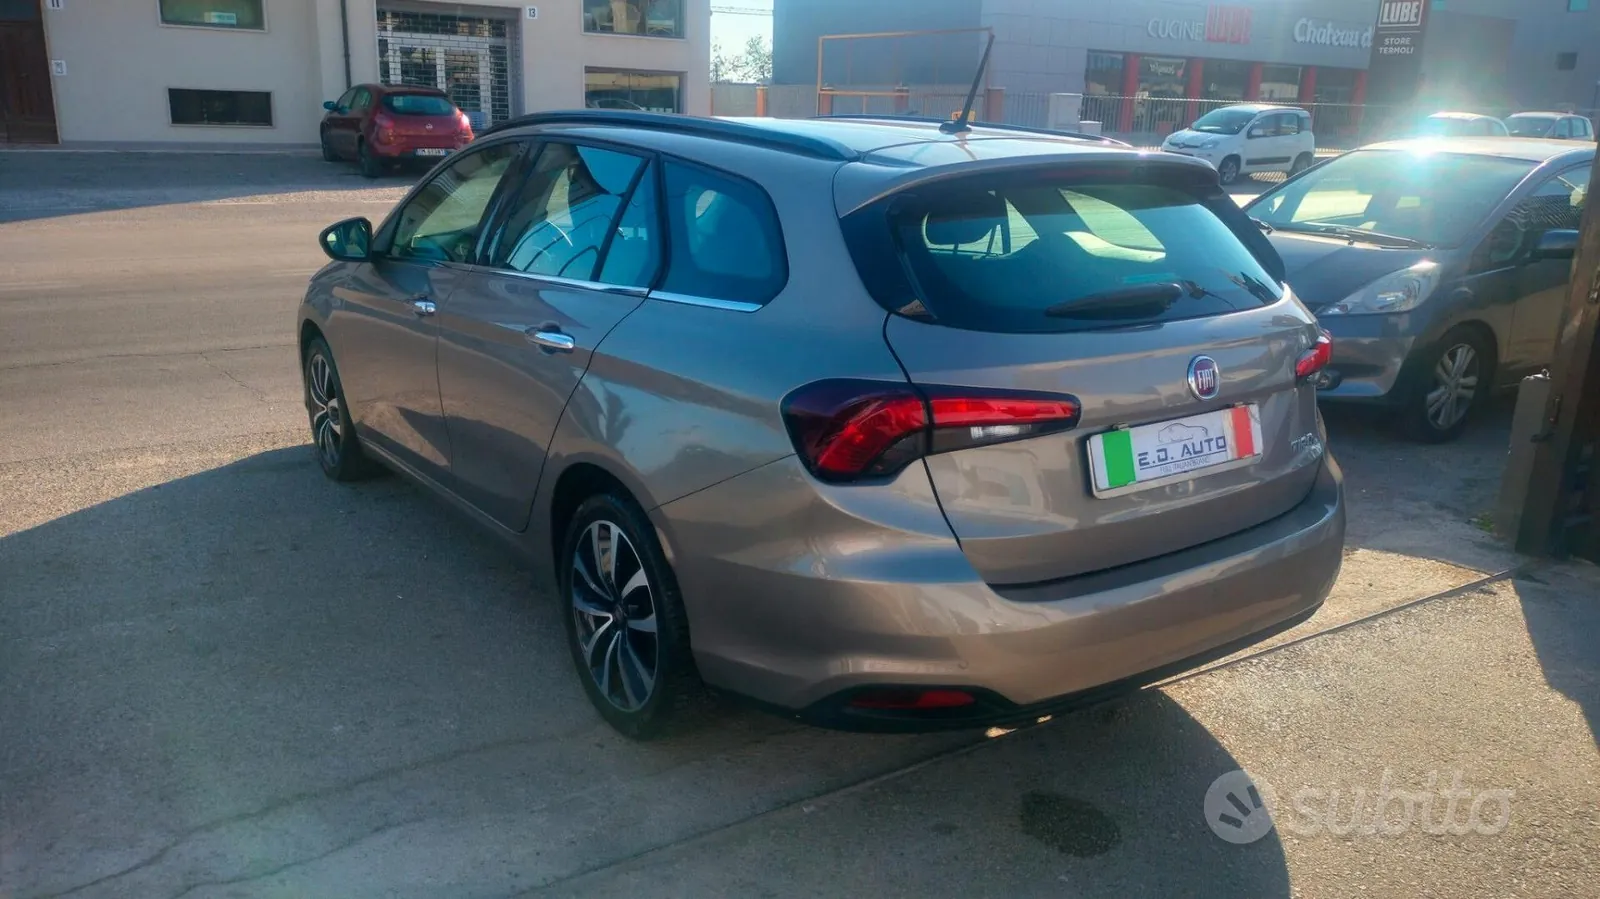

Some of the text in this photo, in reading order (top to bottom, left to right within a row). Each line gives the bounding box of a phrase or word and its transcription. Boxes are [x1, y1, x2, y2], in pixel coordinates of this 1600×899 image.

[528, 7, 536, 18] 13
[1382, 2, 1420, 22] LUBE
[1147, 17, 1205, 41] CUCINE
[1293, 17, 1374, 48] Chateau d
[1379, 46, 1414, 54] TERMOLI
[1383, 37, 1412, 45] STORE
[1196, 368, 1215, 390] FIAT
[1180, 435, 1227, 458] AUTO
